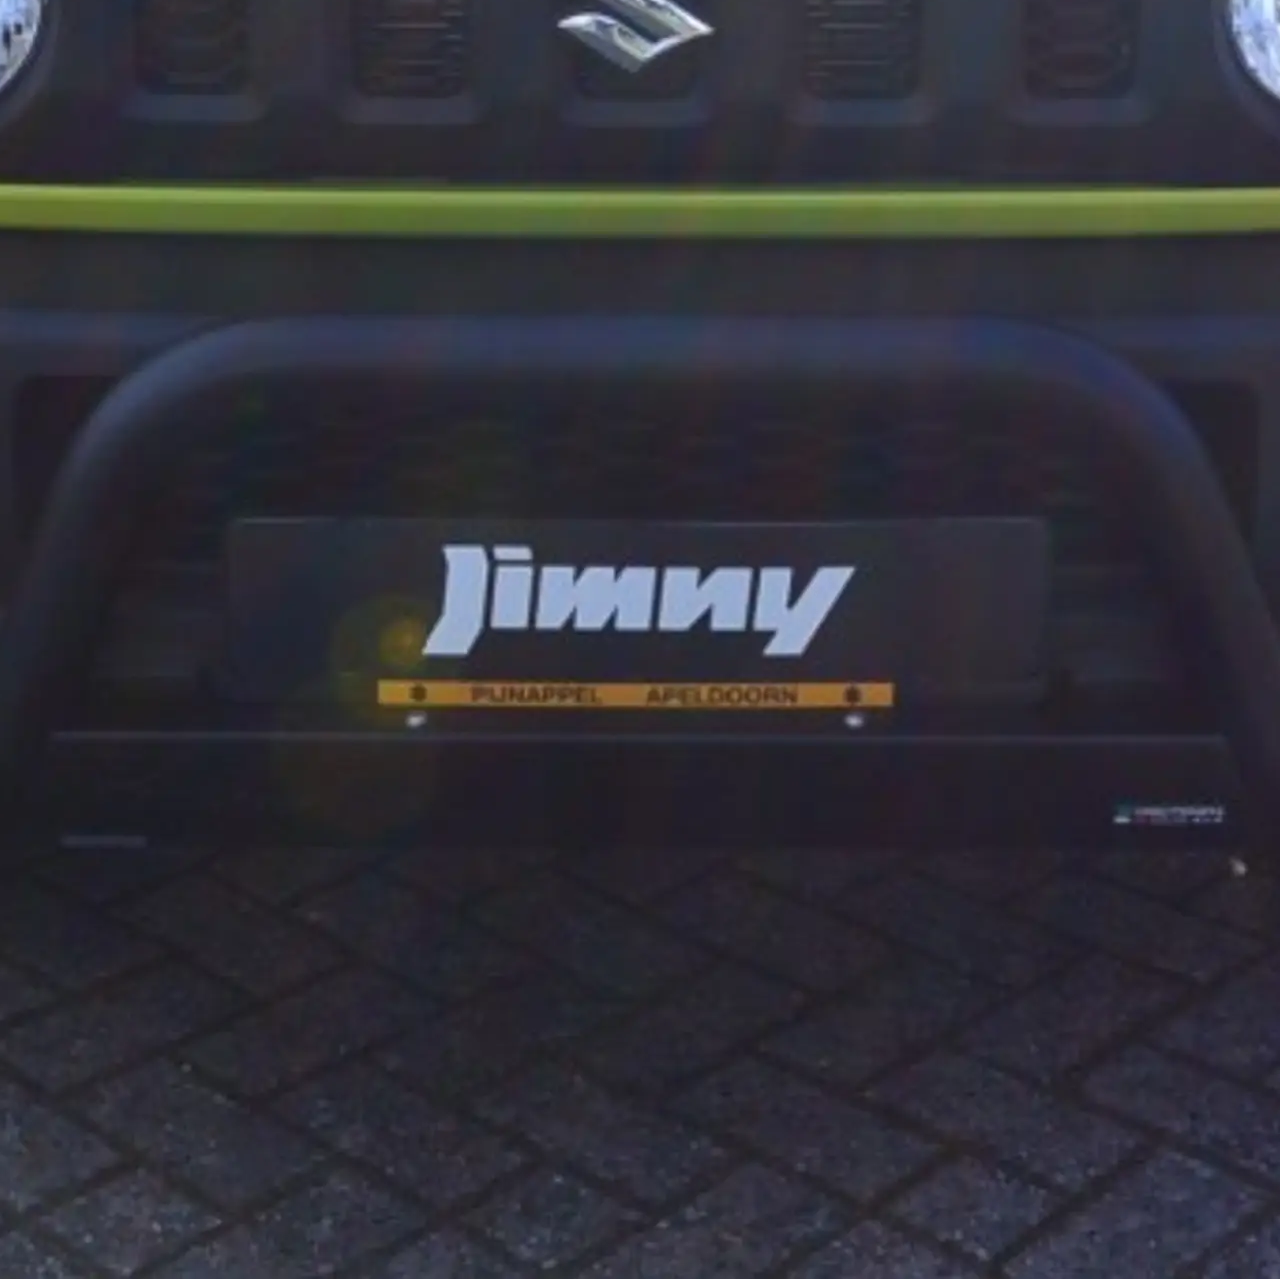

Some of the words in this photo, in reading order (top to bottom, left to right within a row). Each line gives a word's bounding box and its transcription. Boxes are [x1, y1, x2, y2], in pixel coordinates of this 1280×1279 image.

[422, 544, 856, 656] Jimmy
[471, 685, 603, 705] PIJNAPPEL
[646, 686, 799, 706] APELDOORN
